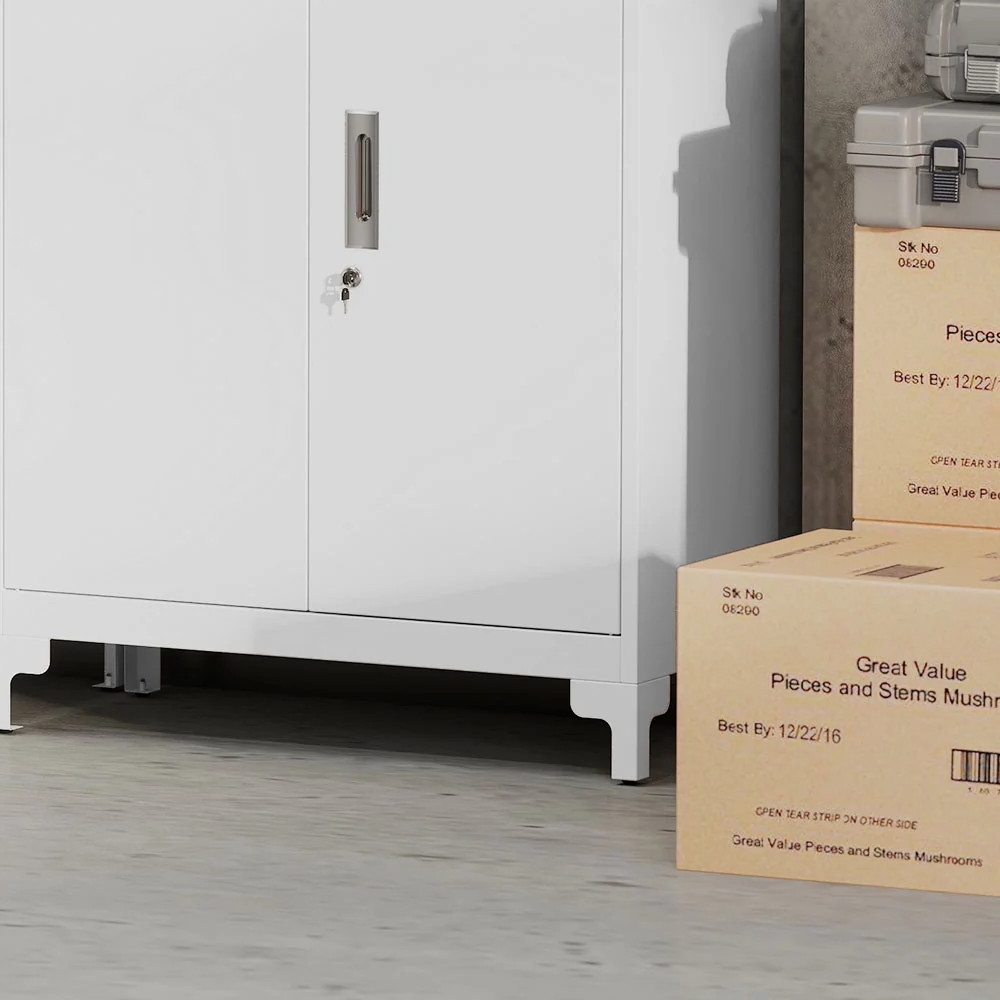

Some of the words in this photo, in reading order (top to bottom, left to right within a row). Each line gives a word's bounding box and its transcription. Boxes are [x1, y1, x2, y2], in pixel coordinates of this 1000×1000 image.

[920, 242, 939, 255] No
[893, 369, 924, 386] Best
[929, 372, 950, 389] By:
[953, 373, 1000, 392] 12/22/
[929, 455, 957, 467] OPEN
[960, 457, 985, 468] TEAR
[907, 482, 939, 496] Great
[942, 485, 976, 499] Value
[745, 588, 764, 601] No
[856, 655, 908, 676] Great
[914, 660, 967, 682] Value
[771, 672, 832, 694] Pieces
[839, 682, 873, 698] and
[879, 681, 937, 704] Stems
[717, 718, 749, 734] Best
[754, 722, 775, 739] By:
[778, 723, 842, 745] 12/22/16
[755, 806, 783, 817] OPEN
[785, 809, 811, 820] TEAR
[812, 811, 842, 823] STRIP
[843, 814, 858, 824] ON
[859, 815, 894, 828] OTHER
[895, 819, 919, 831] SIDE
[732, 834, 764, 848] Great
[766, 837, 802, 852] Value
[847, 846, 871, 857] and
[872, 846, 911, 861] Stems
[914, 850, 984, 868] Mushrooms
